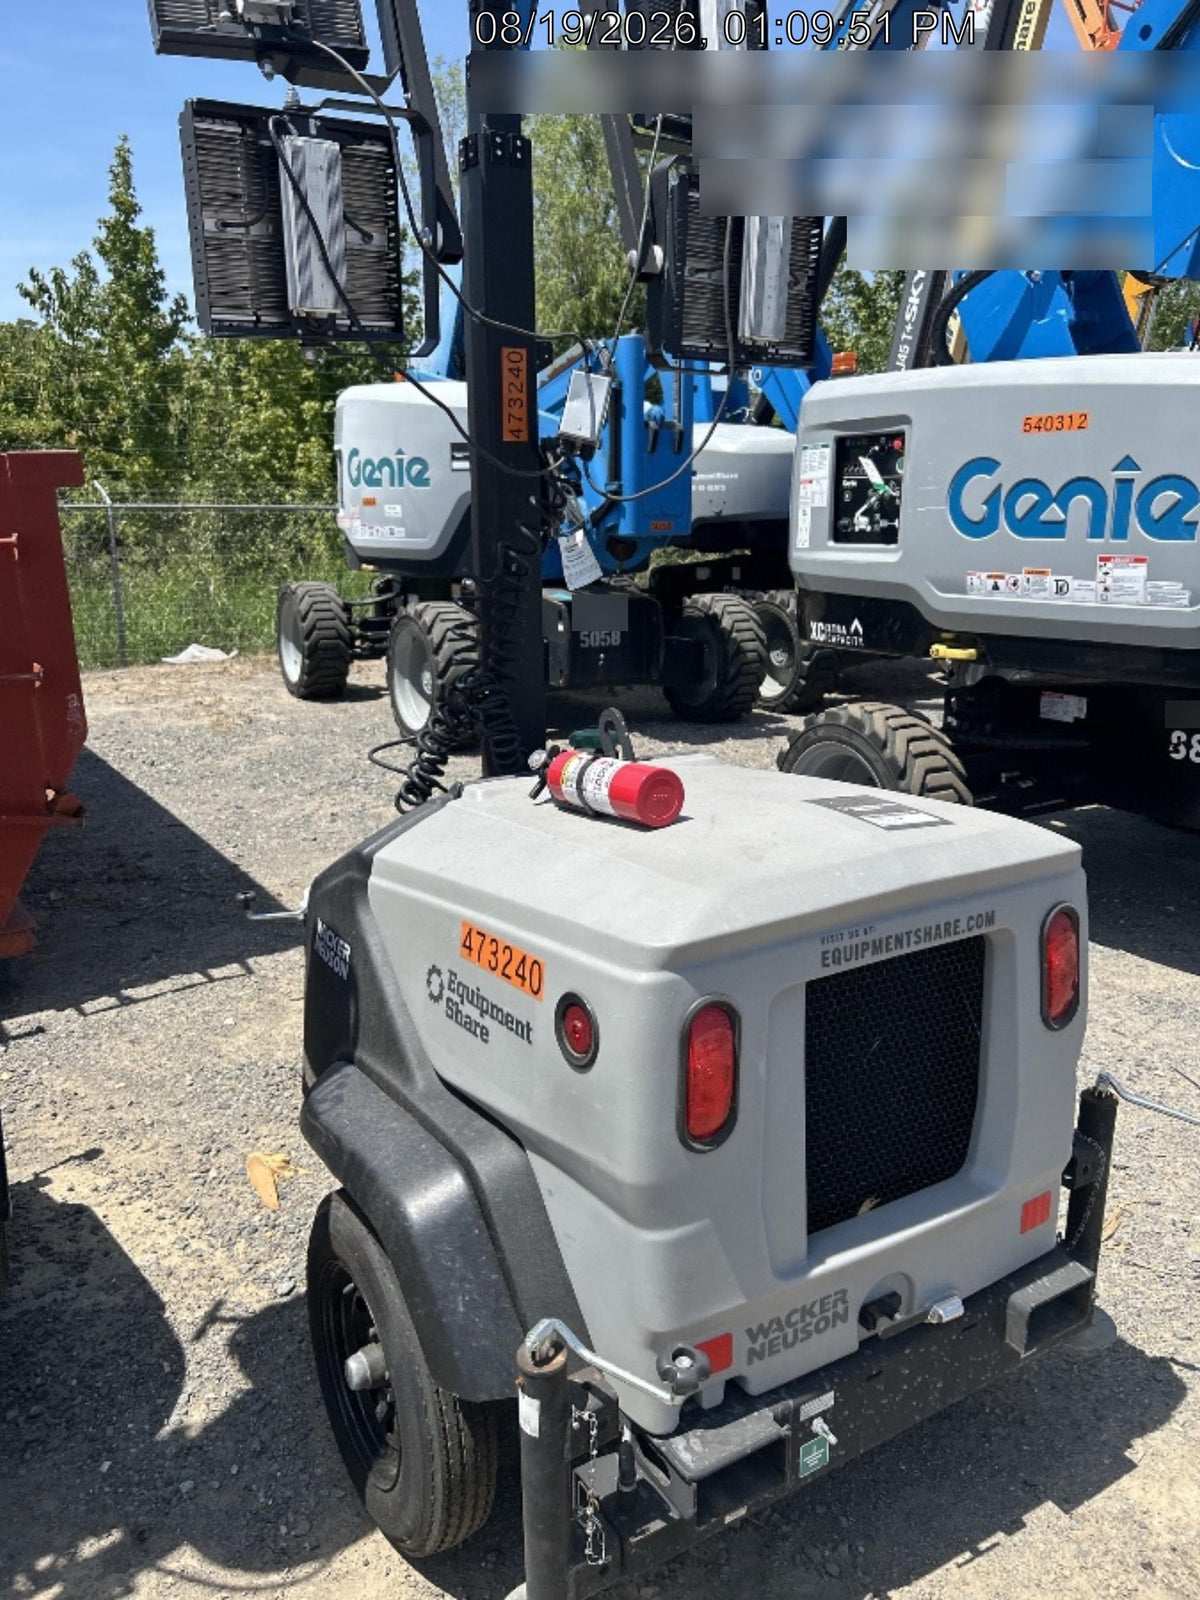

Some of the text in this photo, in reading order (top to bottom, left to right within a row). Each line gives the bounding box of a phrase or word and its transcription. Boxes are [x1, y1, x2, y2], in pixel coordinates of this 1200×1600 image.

[506, 350, 525, 440] 473240
[1023, 413, 1088, 433] 540312
[348, 447, 431, 488] Genie
[947, 454, 1200, 542] Genie
[461, 927, 543, 996] 473240
[820, 932, 844, 946] VISIT
[848, 930, 859, 939] US
[821, 910, 996, 968] EQUIPMENTSHARE.COM
[445, 996, 490, 1044] Share
[446, 968, 532, 1045] Equipment
[744, 1288, 849, 1345] WACKER
[746, 1304, 849, 1366] NEUSON
